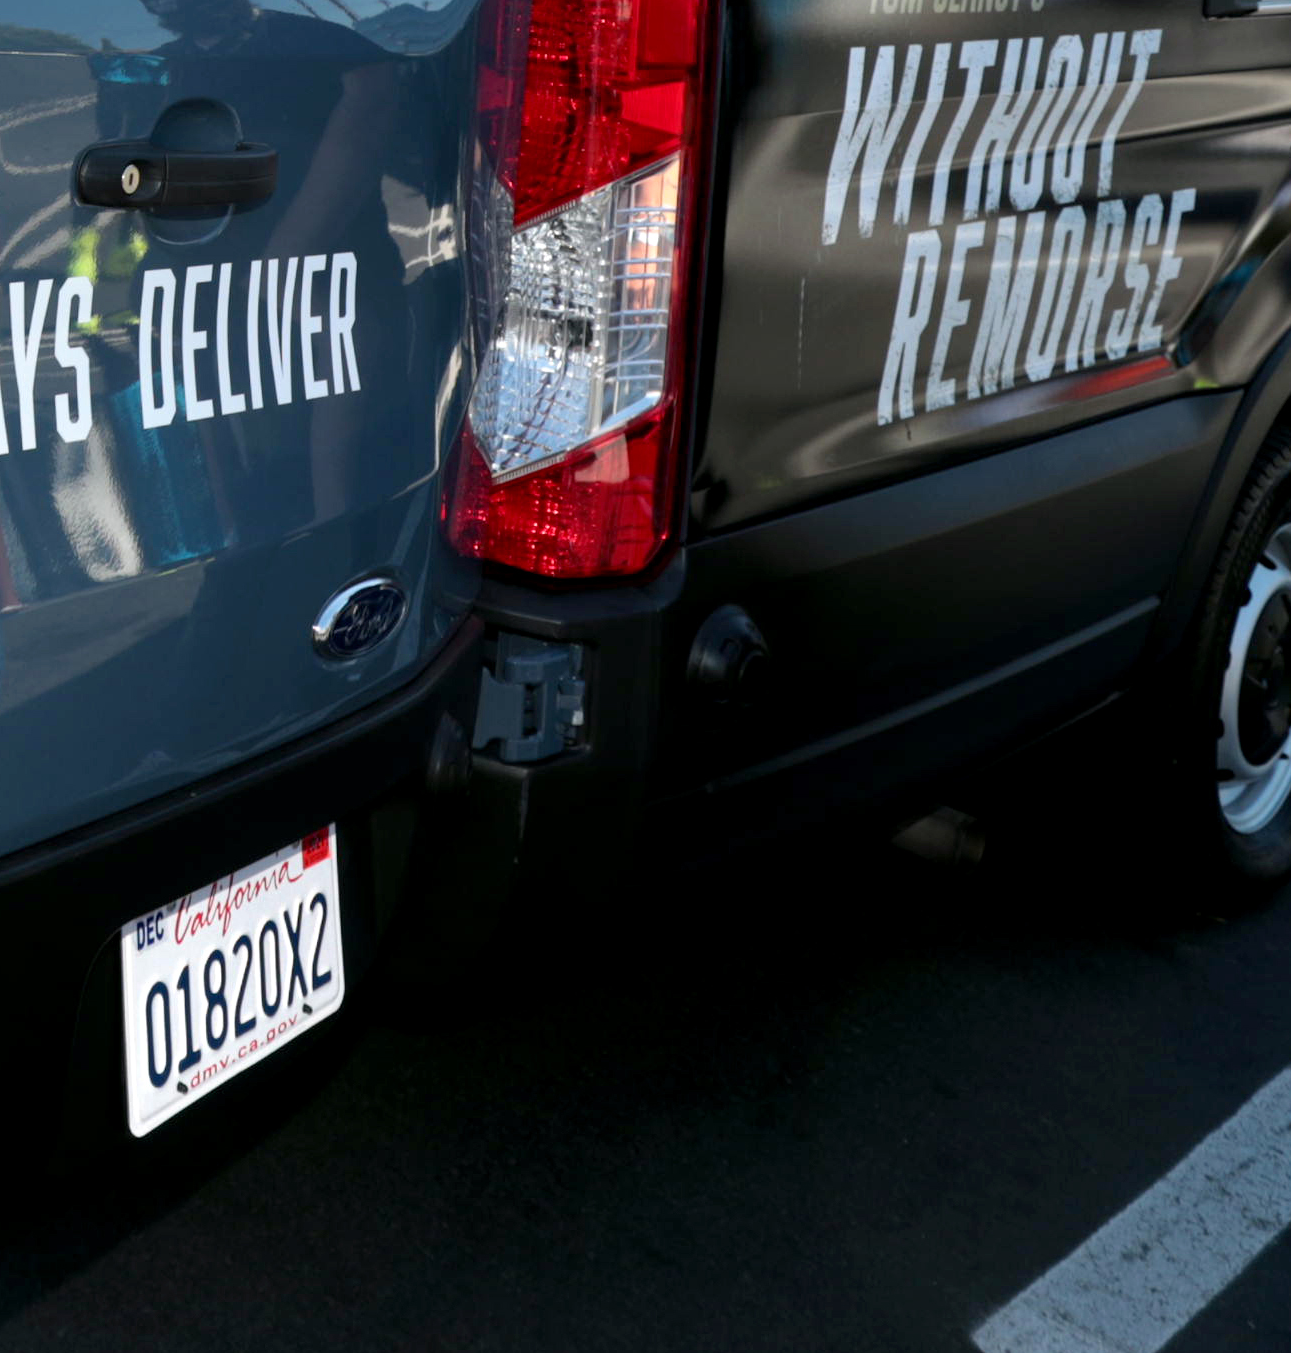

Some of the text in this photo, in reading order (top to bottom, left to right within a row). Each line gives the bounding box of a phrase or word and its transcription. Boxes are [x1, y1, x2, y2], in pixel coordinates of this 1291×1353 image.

[821, 28, 1163, 246] WITHOUT
[138, 251, 361, 430] DELIVER
[877, 188, 1197, 426] REMORSE
[136, 911, 165, 951] DEC
[145, 891, 332, 1088] 01820X2
[173, 861, 304, 945] California
[190, 1013, 299, 1089] dmv.ca.gov
